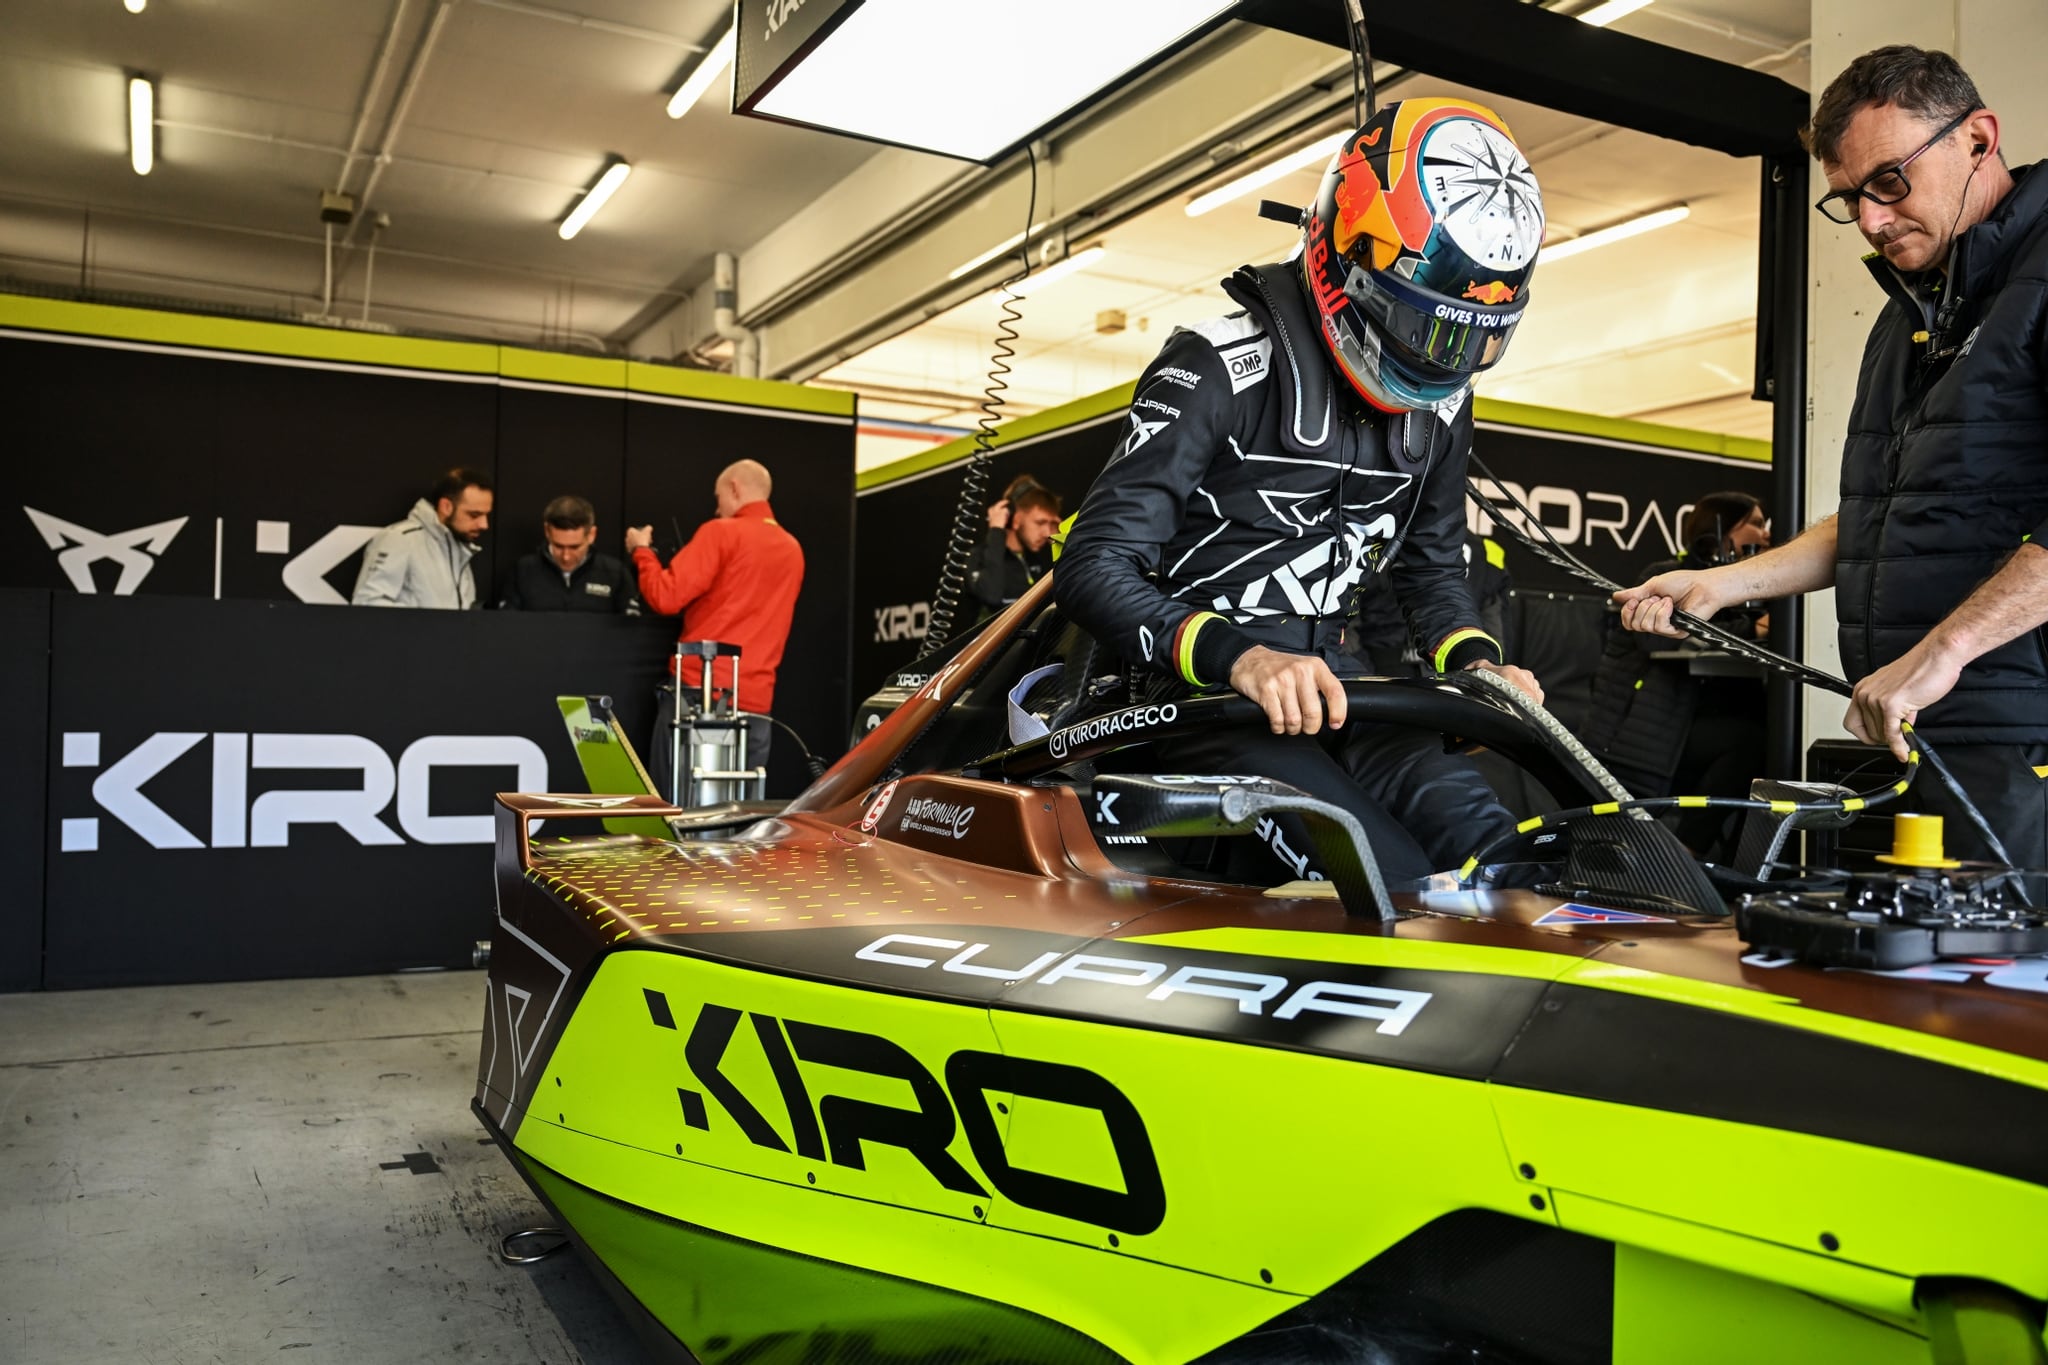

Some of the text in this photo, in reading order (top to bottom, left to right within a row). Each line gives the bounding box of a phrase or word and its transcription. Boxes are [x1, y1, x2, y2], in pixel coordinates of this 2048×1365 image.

[1501, 245, 1513, 261] N
[1435, 304, 1473, 324] GIVES
[1475, 312, 1500, 327] YOU
[1231, 354, 1263, 376] OMP
[875, 602, 931, 642] KIRO
[1068, 703, 1178, 747] KIRORACECO
[61, 732, 548, 852] KIRO
[919, 798, 960, 826] FORMULA
[855, 933, 1433, 1036] CUPRA
[642, 987, 1167, 1236] KIRO
